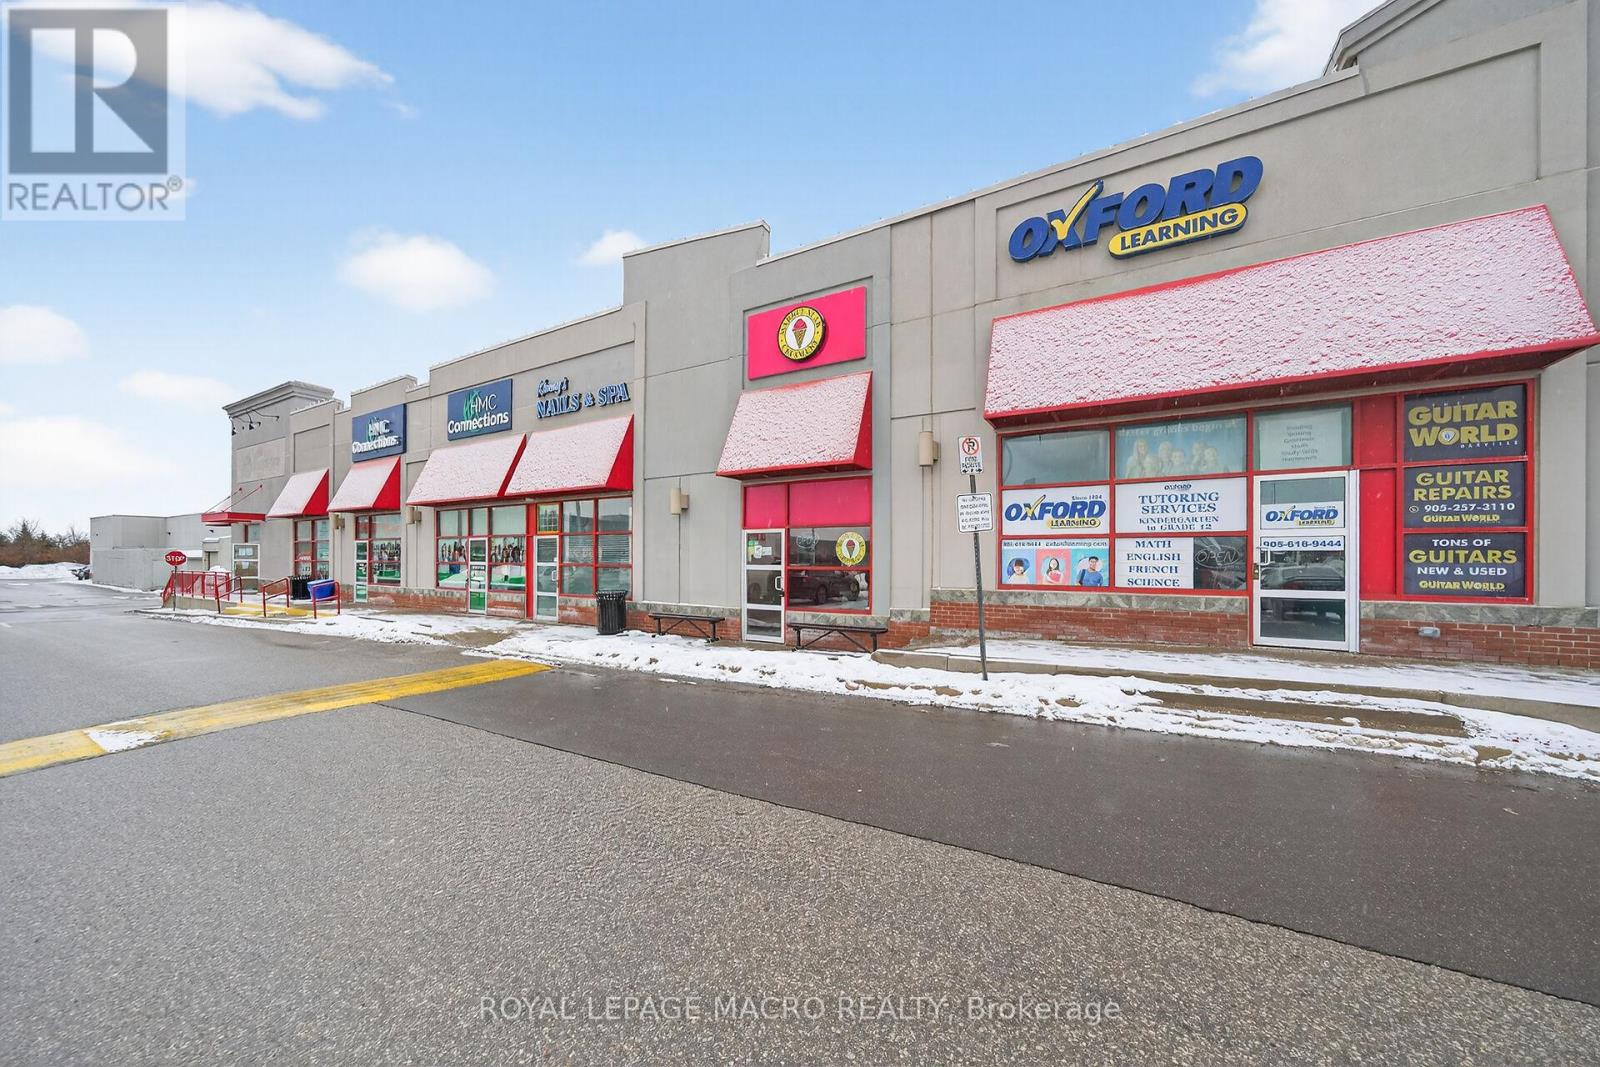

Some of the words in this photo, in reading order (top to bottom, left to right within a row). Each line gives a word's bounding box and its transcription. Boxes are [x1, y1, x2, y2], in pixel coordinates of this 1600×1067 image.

[1008, 155, 1264, 263] OXFORD
[1120, 207, 1239, 252] LEARNING
[471, 393, 497, 414] HMC
[536, 393, 583, 419] NAILS
[583, 391, 596, 408] &
[597, 382, 631, 407] SPA
[1408, 400, 1518, 426] GUITAR
[448, 411, 509, 434] Connections
[1409, 423, 1519, 448] WORLD
[1415, 469, 1510, 486] GUITAR
[1138, 491, 1220, 505] TUTORING
[1413, 485, 1513, 502] REPAIRS
[1004, 494, 1107, 522] OXFORD
[1141, 502, 1217, 515] SERVICES
[1424, 502, 1516, 513] 905-257-3110
[1422, 514, 1461, 523] GUITAR
[1135, 540, 1172, 549] MATH
[1432, 538, 1468, 547] TONS
[1472, 538, 1492, 547] OF
[1126, 552, 1181, 562] ENGLISH
[1197, 549, 1237, 566] OPEN
[1408, 549, 1518, 564] GUITARS
[1128, 565, 1179, 574] FRENCH
[1417, 566, 1450, 576] NEW
[1453, 566, 1464, 576] &
[1469, 566, 1508, 576] USED
[1127, 577, 1180, 587] SCIENCE
[1419, 580, 1460, 590] GUITAR
[1461, 580, 1506, 591] WORLD
